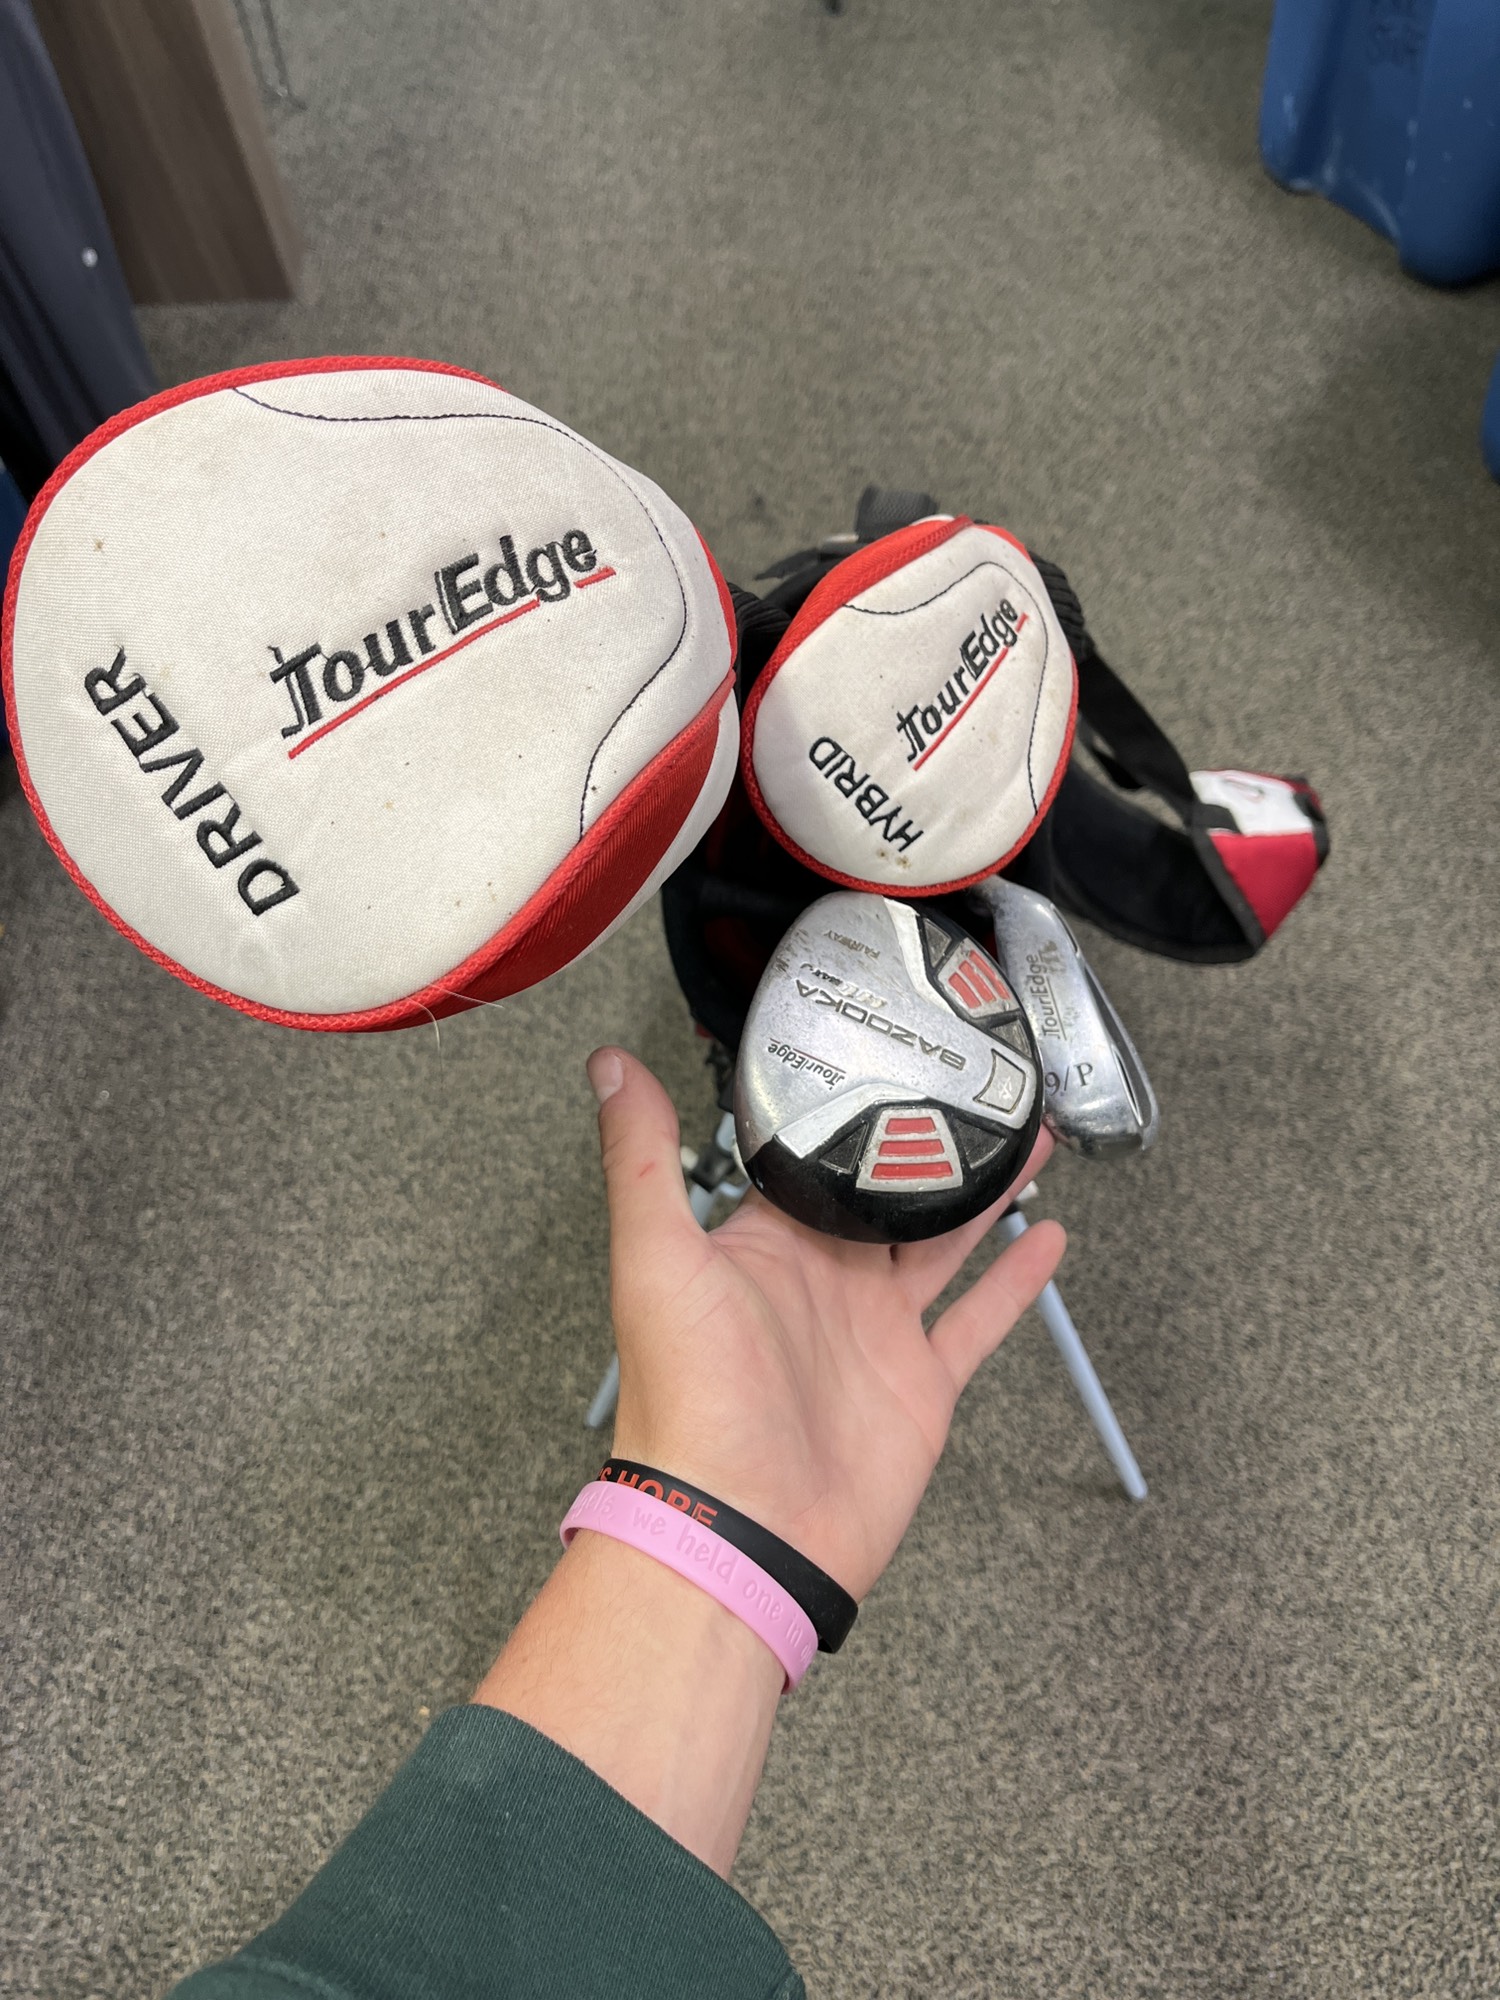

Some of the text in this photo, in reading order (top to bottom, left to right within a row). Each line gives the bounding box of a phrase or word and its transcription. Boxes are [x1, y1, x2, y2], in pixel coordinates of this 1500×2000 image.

[84, 645, 300, 917] DRIVER
[808, 736, 924, 852] HYBRID
[795, 978, 967, 1072] BAZOOKA
[633, 1506, 667, 1536] we
[676, 1523, 740, 1586] held
[743, 1578, 784, 1622] one
